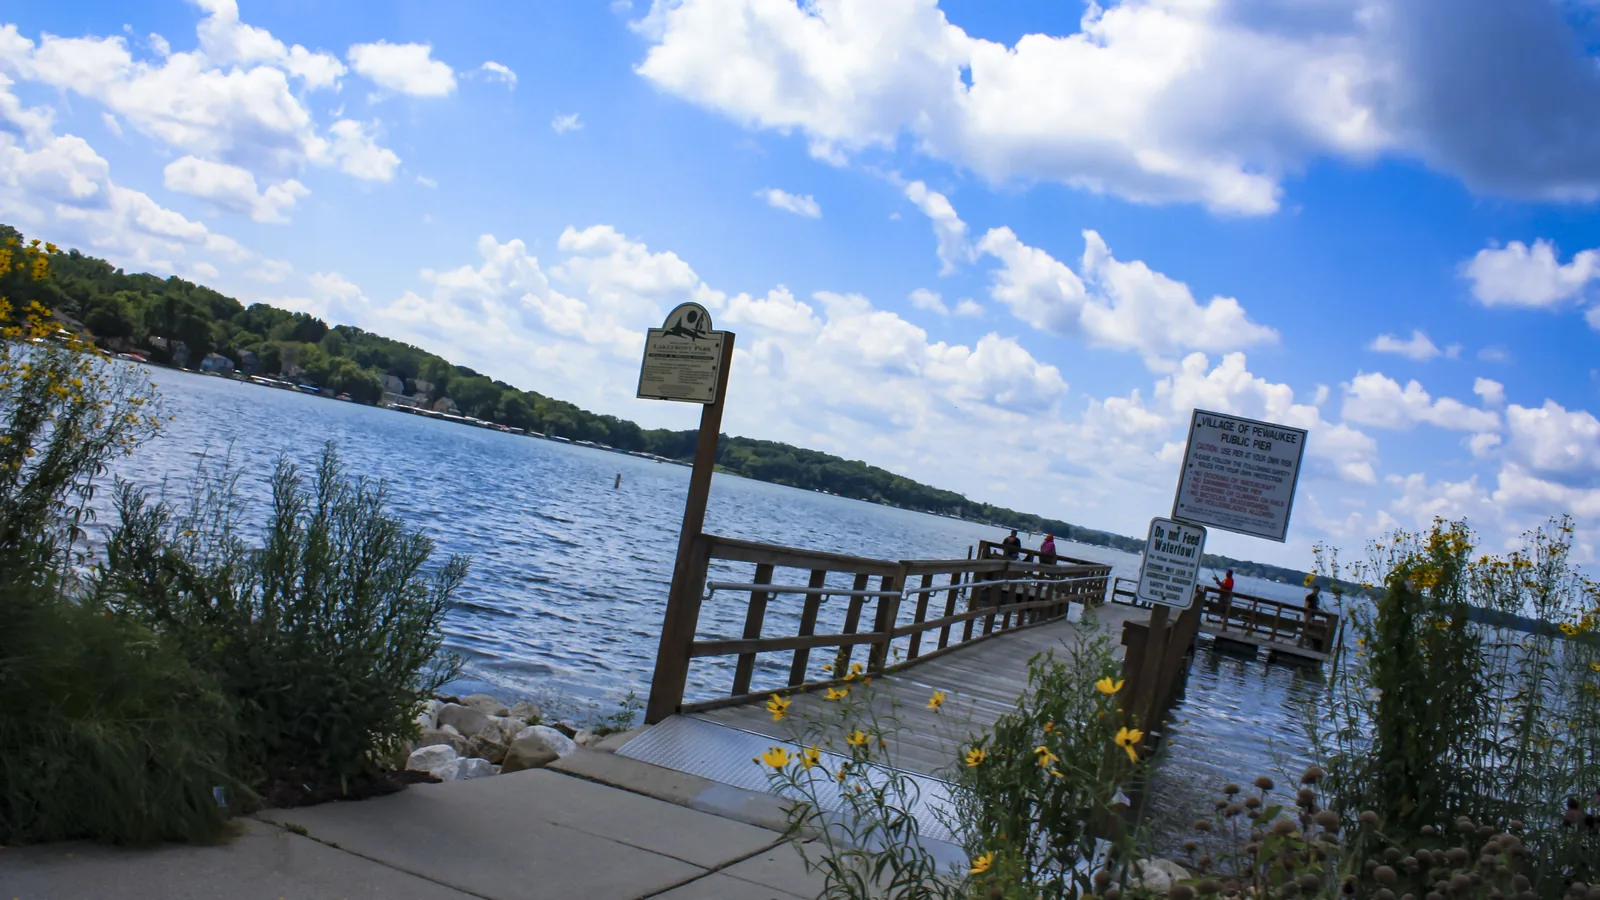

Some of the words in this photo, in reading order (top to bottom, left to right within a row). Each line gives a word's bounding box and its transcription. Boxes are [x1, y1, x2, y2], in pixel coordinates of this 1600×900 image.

[1201, 417, 1235, 432] VILLAGE
[1237, 424, 1249, 434] OF
[1252, 426, 1298, 443] PEWAUKEE
[1221, 434, 1250, 447] PUBLIC
[1253, 440, 1272, 451] PIER
[1193, 453, 1211, 462] PLEASE
[1212, 457, 1231, 466] FOLLOW
[1243, 463, 1271, 473] FOLLOWING
[1272, 468, 1290, 477] SAFETY
[1220, 447, 1232, 455] USE
[1232, 449, 1244, 458] PIER
[1252, 453, 1266, 462] YOUR
[1267, 456, 1280, 465] OWN
[1280, 458, 1293, 467] RISK
[1198, 462, 1213, 470] RULES
[1226, 467, 1239, 475] YOUR
[1203, 472, 1229, 482] DOCKING
[1240, 479, 1276, 491] WATERCRAFT
[1235, 492, 1259, 502] CLIMBING
[1155, 526, 1165, 538] Do
[1168, 529, 1180, 541] not
[1183, 532, 1200, 546] Feed
[1154, 539, 1196, 558] Waterfowl
